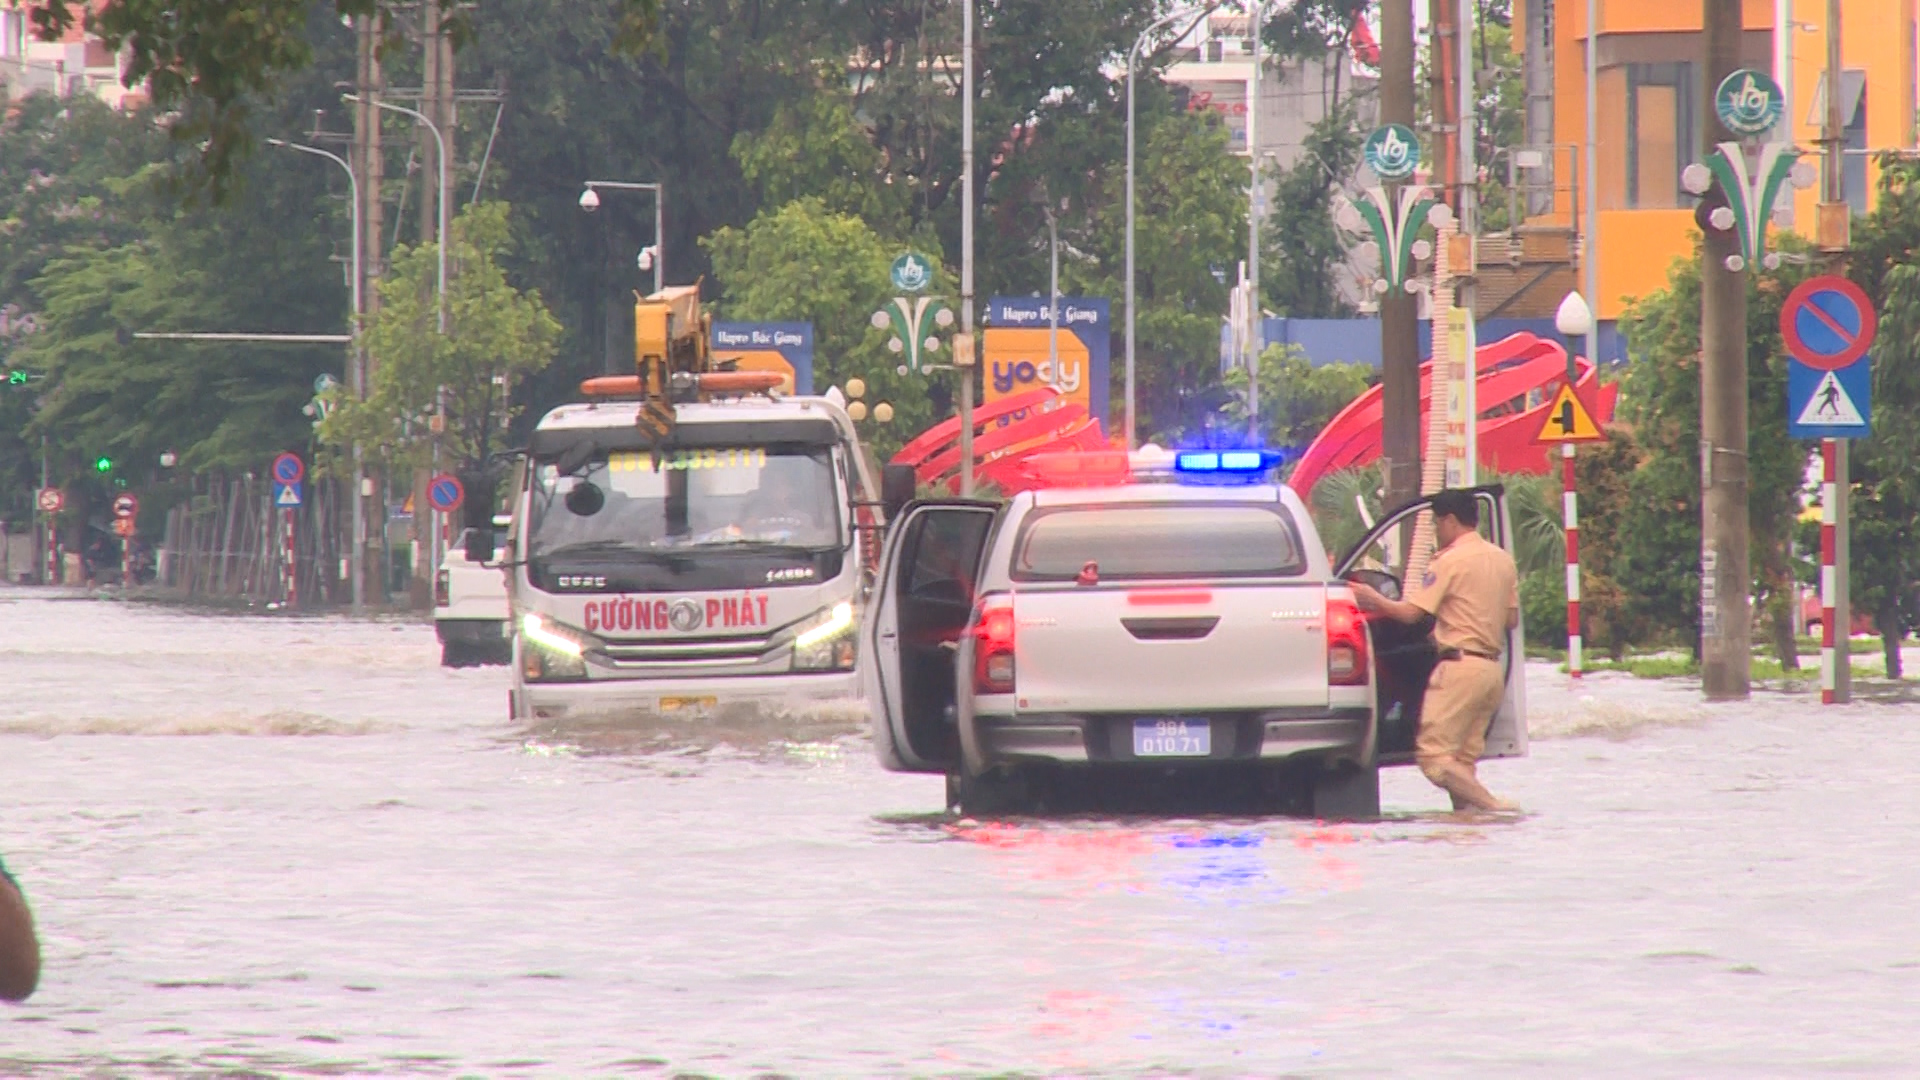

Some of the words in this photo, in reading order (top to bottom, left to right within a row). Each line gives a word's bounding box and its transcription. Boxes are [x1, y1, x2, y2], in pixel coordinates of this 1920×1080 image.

[1002, 305, 1038, 324] Hapro
[1065, 305, 1098, 324] Giang
[584, 592, 669, 632] CƯỜNG
[705, 588, 769, 628] PHÁT
[1156, 720, 1188, 737] 98A
[1143, 737, 1201, 753] 010.71
